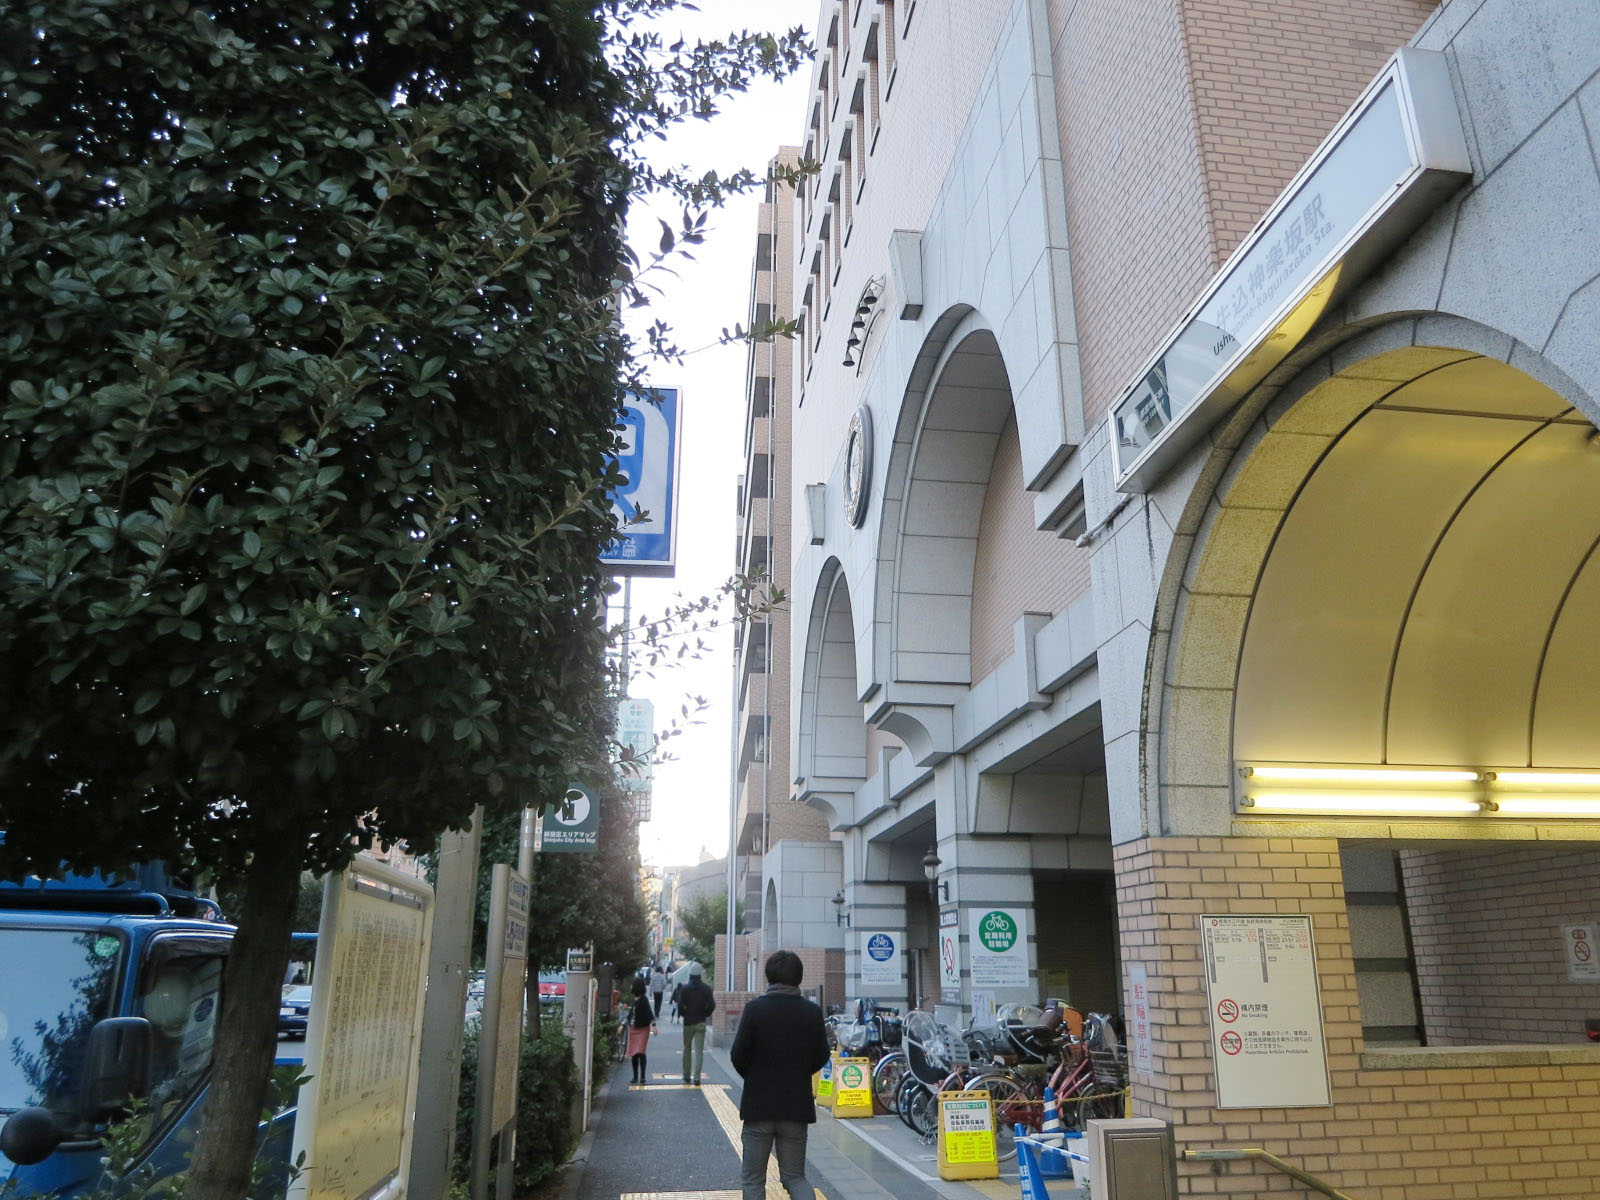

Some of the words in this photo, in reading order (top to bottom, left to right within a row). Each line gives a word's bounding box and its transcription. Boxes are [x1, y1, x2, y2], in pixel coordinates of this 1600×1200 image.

[1213, 245, 1312, 356] Ushigome-kagurazaka
[1314, 222, 1336, 248] Sta.
[1216, 192, 1325, 330] 牛込神楽坂駅
[1241, 1003, 1269, 1012] 構内禁煙
